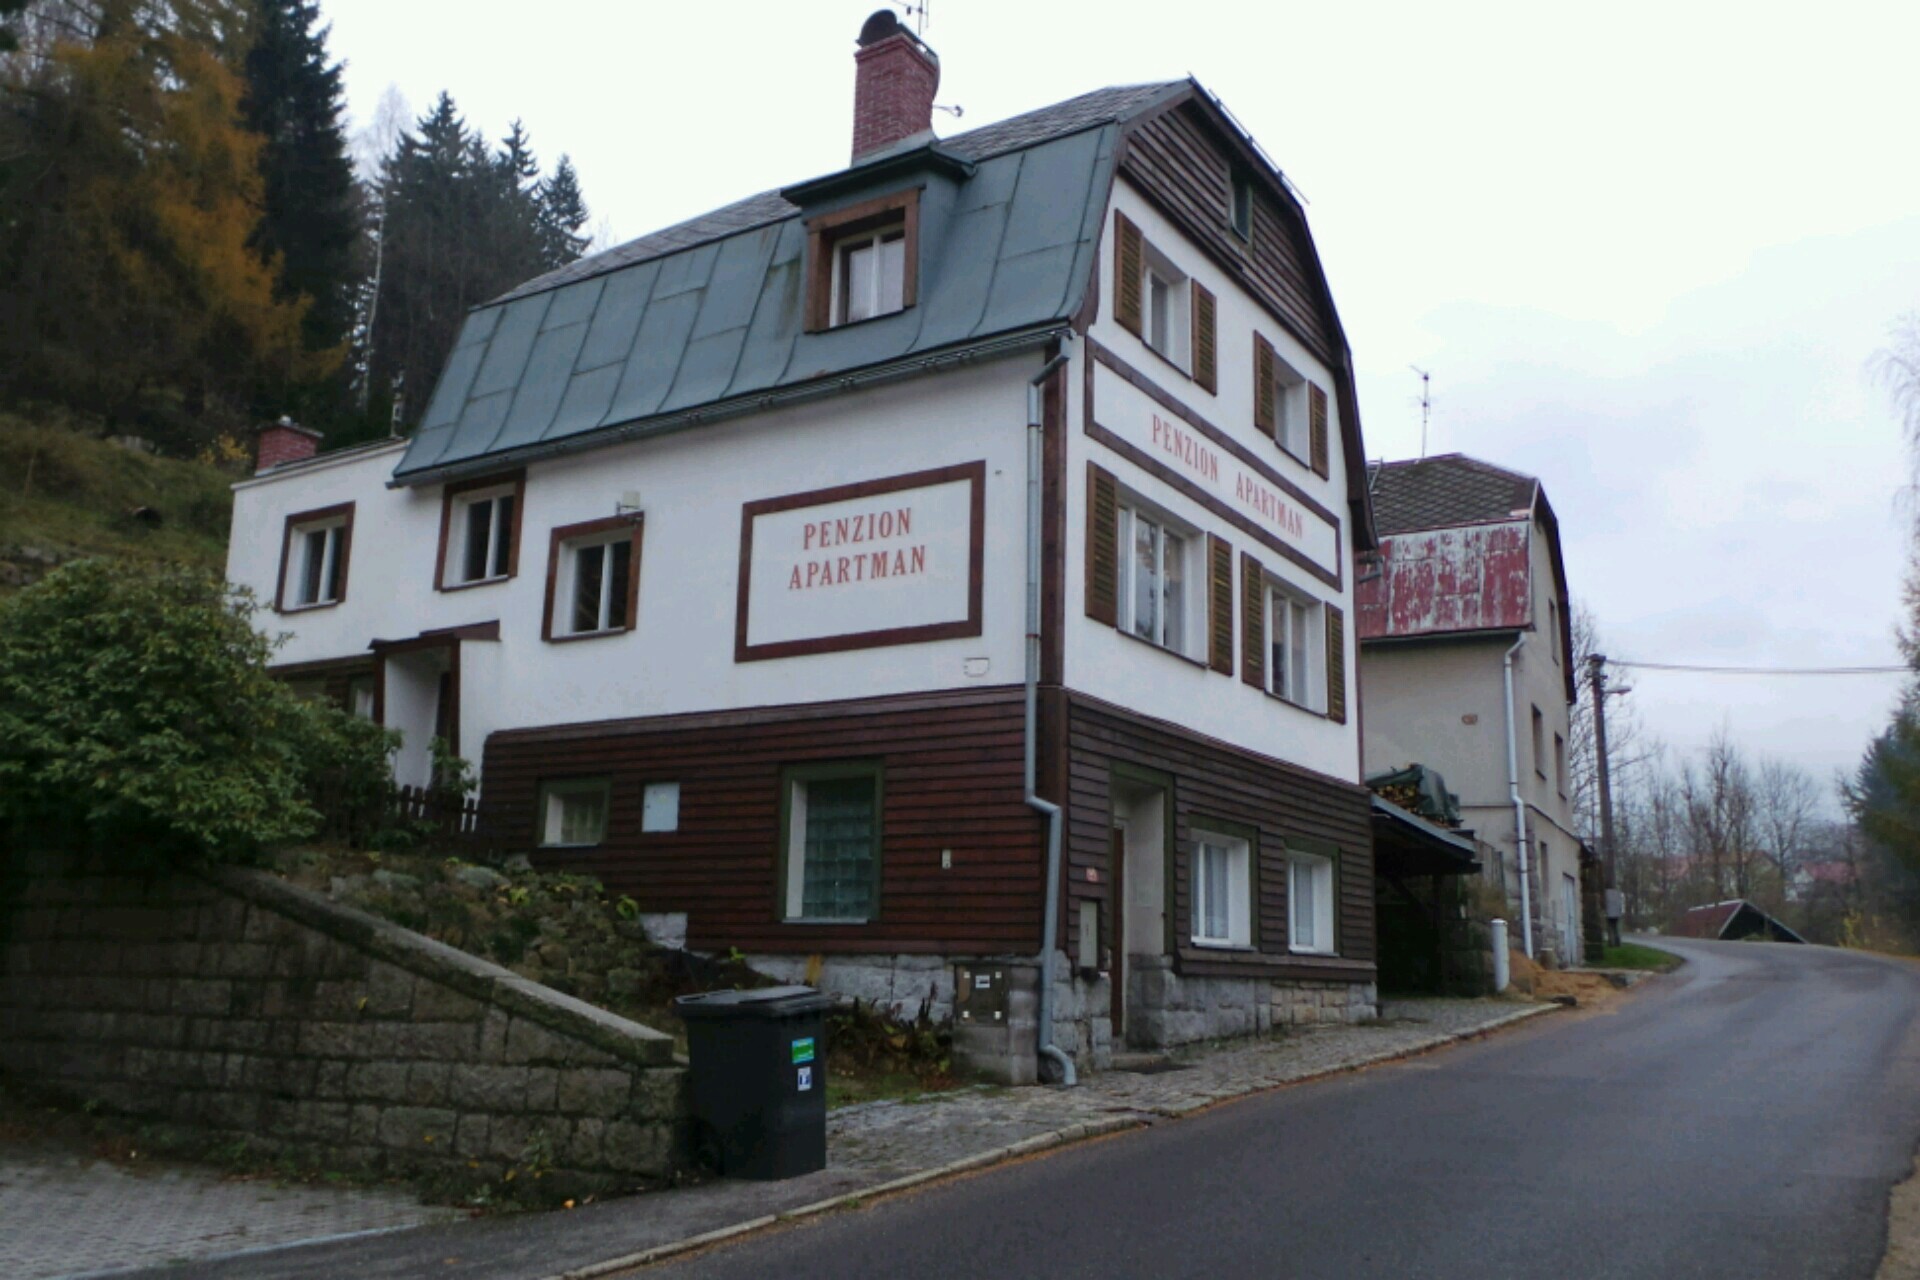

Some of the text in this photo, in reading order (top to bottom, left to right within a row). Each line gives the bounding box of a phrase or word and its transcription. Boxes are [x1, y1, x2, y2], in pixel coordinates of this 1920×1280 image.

[1152, 415, 1302, 538] PENZION APARTMAN
[803, 508, 911, 549] PENZION
[789, 545, 925, 589] APARTMAN
